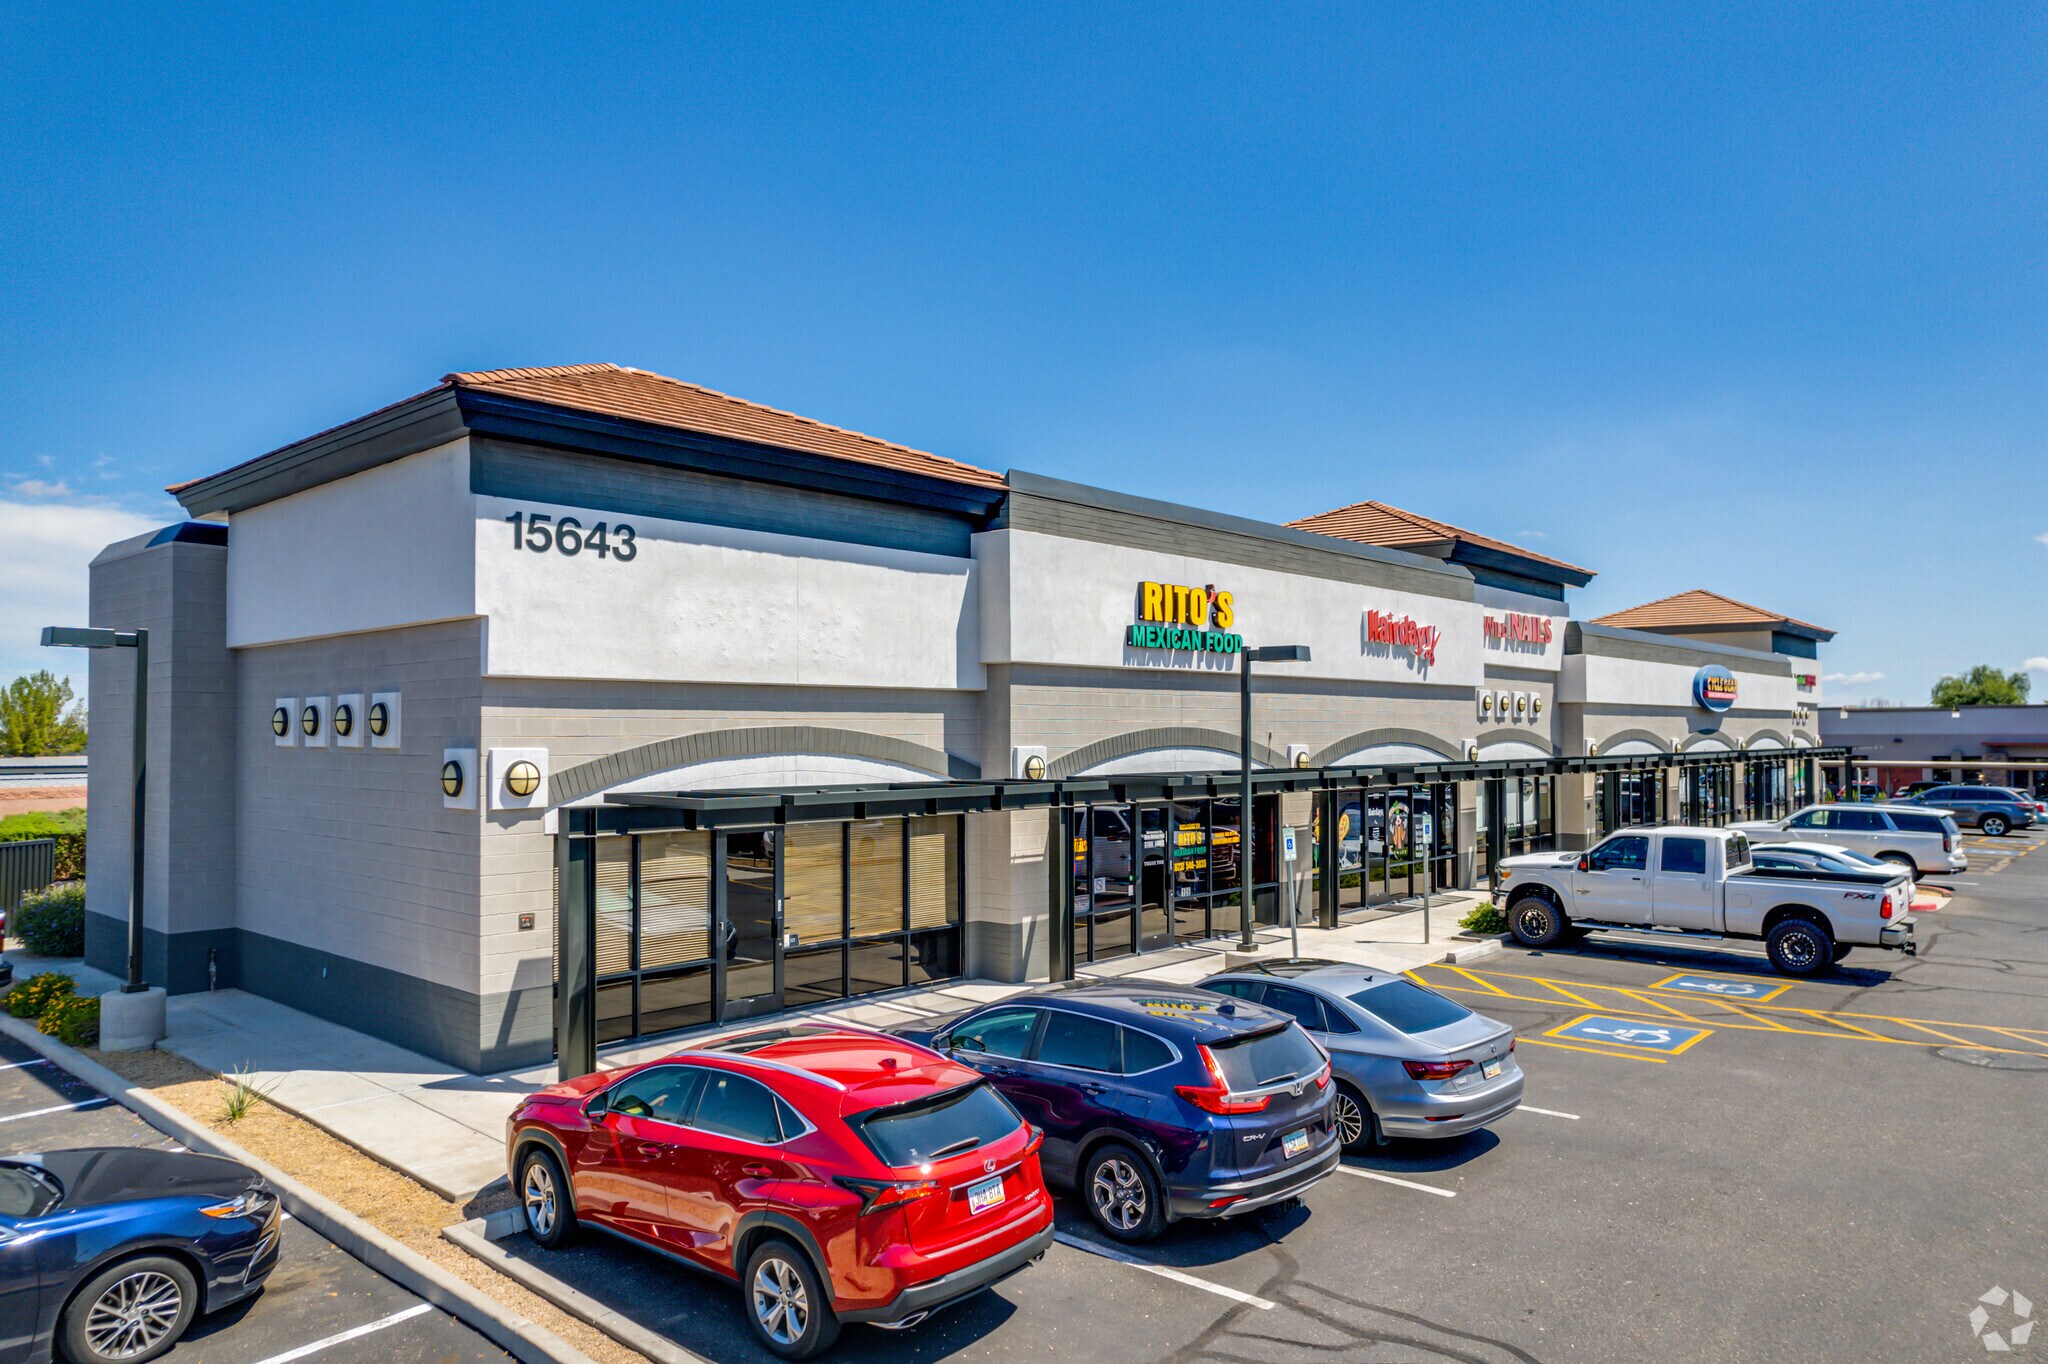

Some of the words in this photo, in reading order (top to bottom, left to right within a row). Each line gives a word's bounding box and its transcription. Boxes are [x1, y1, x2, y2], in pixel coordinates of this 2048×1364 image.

[505, 511, 638, 562] 15643
[1139, 581, 1235, 629] RITO'S
[1128, 625, 1203, 652] MEXICAN
[1203, 631, 1243, 654] FOOD
[1367, 609, 1433, 657] Hairdays
[1507, 612, 1553, 644] NAILS
[1844, 891, 1876, 900] FX4
[1242, 1133, 1266, 1142] CR-V
